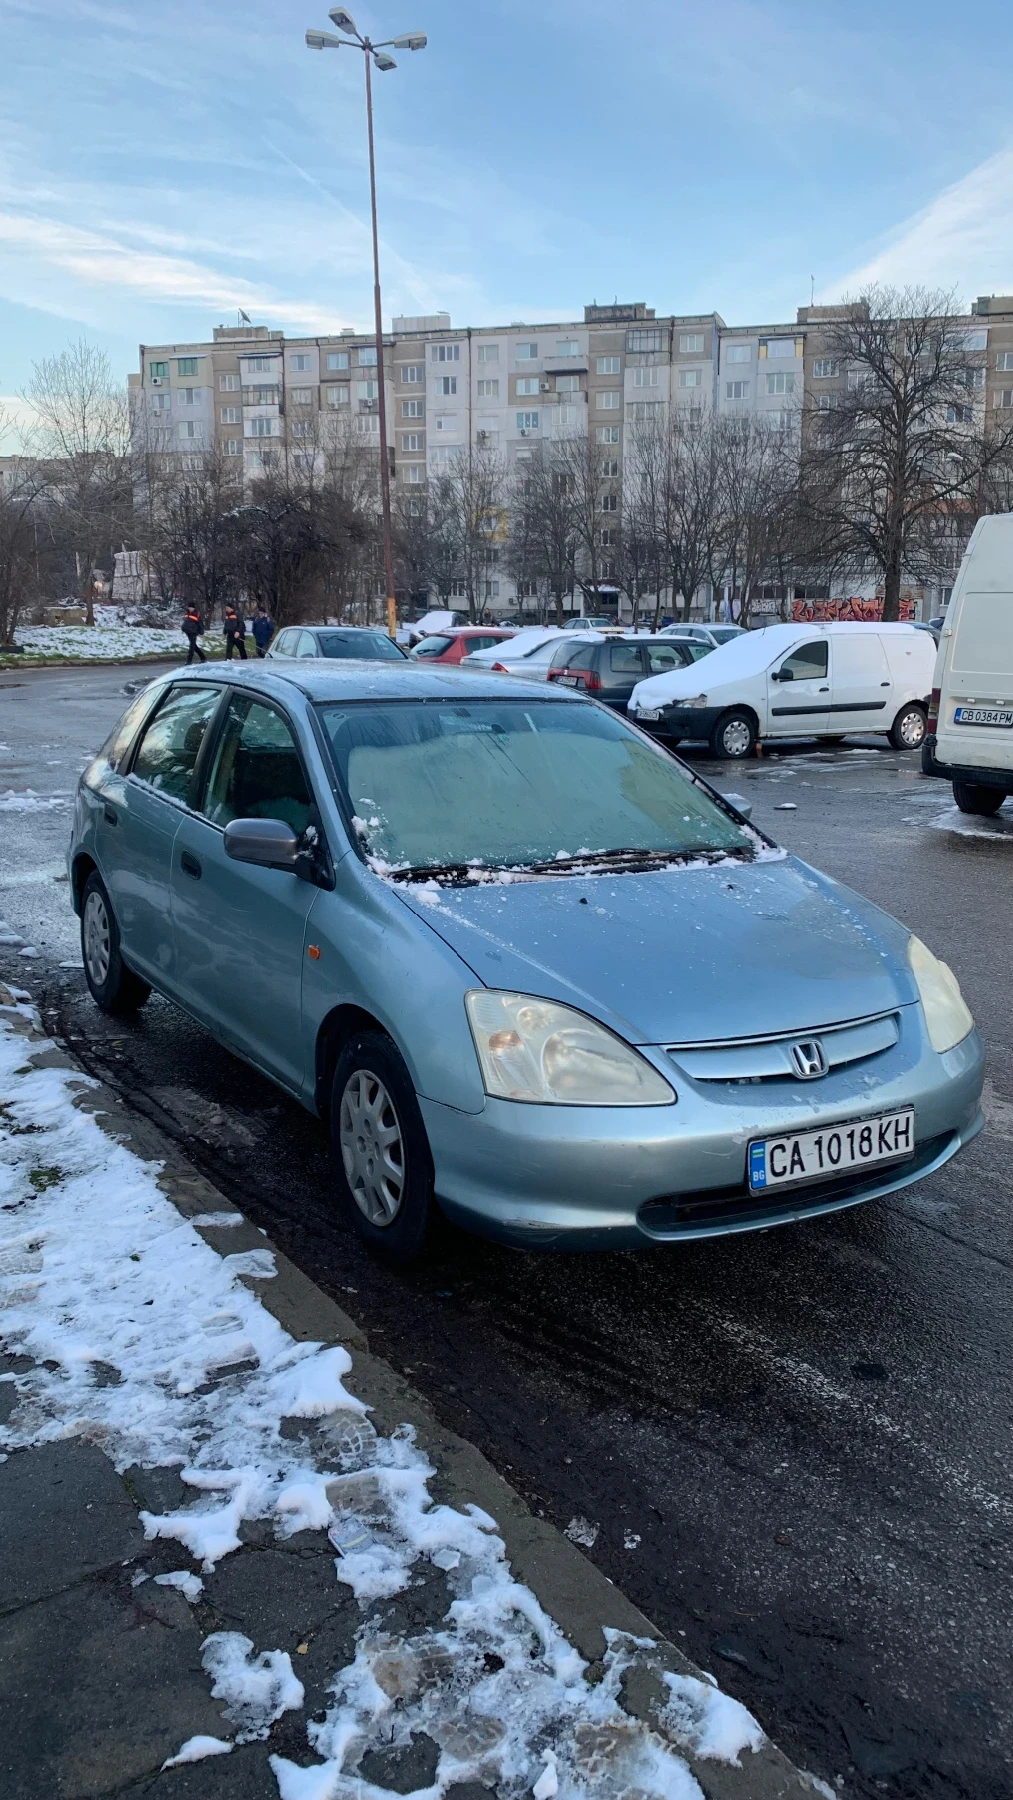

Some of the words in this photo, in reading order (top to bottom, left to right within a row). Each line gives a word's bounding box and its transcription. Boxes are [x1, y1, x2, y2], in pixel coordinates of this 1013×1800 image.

[961, 711, 974, 721] CB
[975, 711, 998, 722] 0384
[998, 713, 1013, 723] PM
[769, 1140, 806, 1177] CA
[814, 1126, 873, 1168] 1018
[878, 1116, 910, 1154] KH
[752, 1169, 765, 1182] BG
